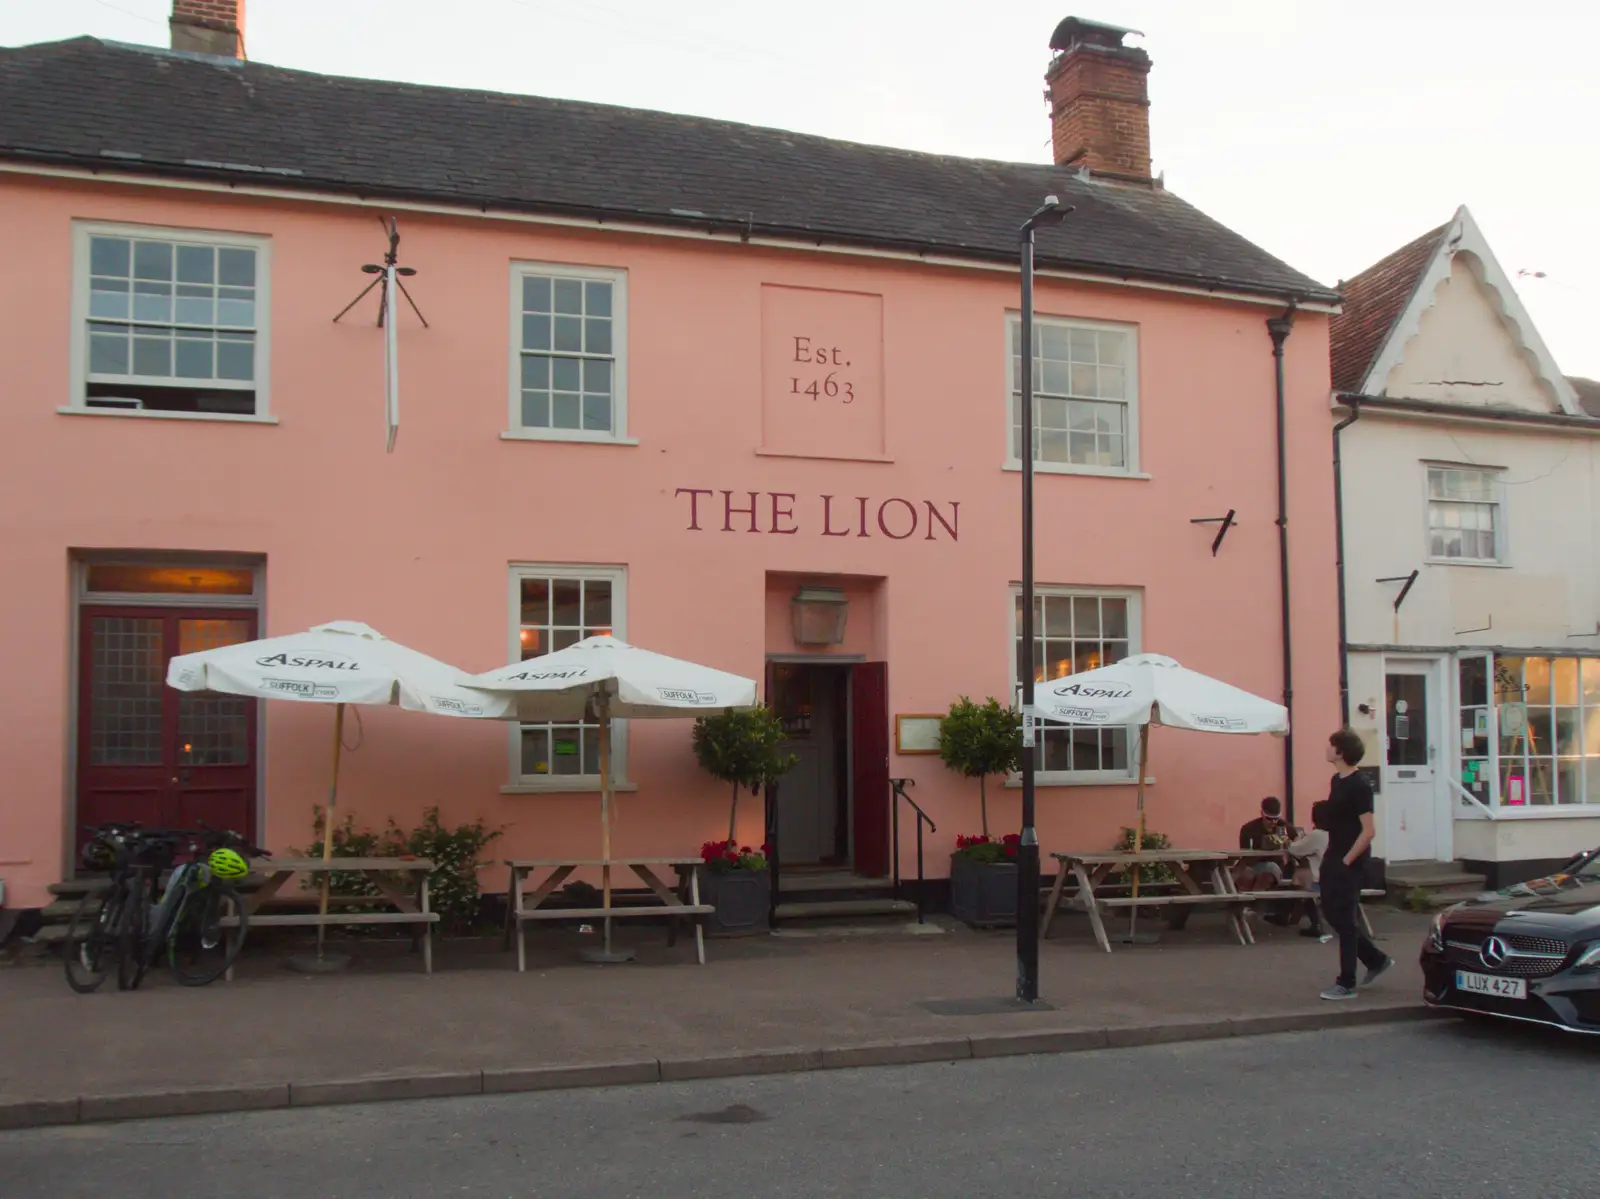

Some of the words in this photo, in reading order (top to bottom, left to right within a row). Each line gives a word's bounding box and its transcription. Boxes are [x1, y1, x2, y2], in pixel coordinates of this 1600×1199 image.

[793, 336, 852, 367] Est.
[790, 371, 855, 404] 1463
[675, 488, 799, 535] THE
[820, 495, 960, 542] LION
[257, 652, 361, 672] ASPALL
[507, 668, 589, 682] ASPALL
[270, 681, 310, 693] SUFFOLK
[663, 690, 694, 700] SUFFOLK
[1054, 683, 1133, 699] ASPALL
[1059, 707, 1091, 717] SUFFOLK
[1466, 975, 1489, 991] LUX
[1492, 980, 1519, 996] 427
